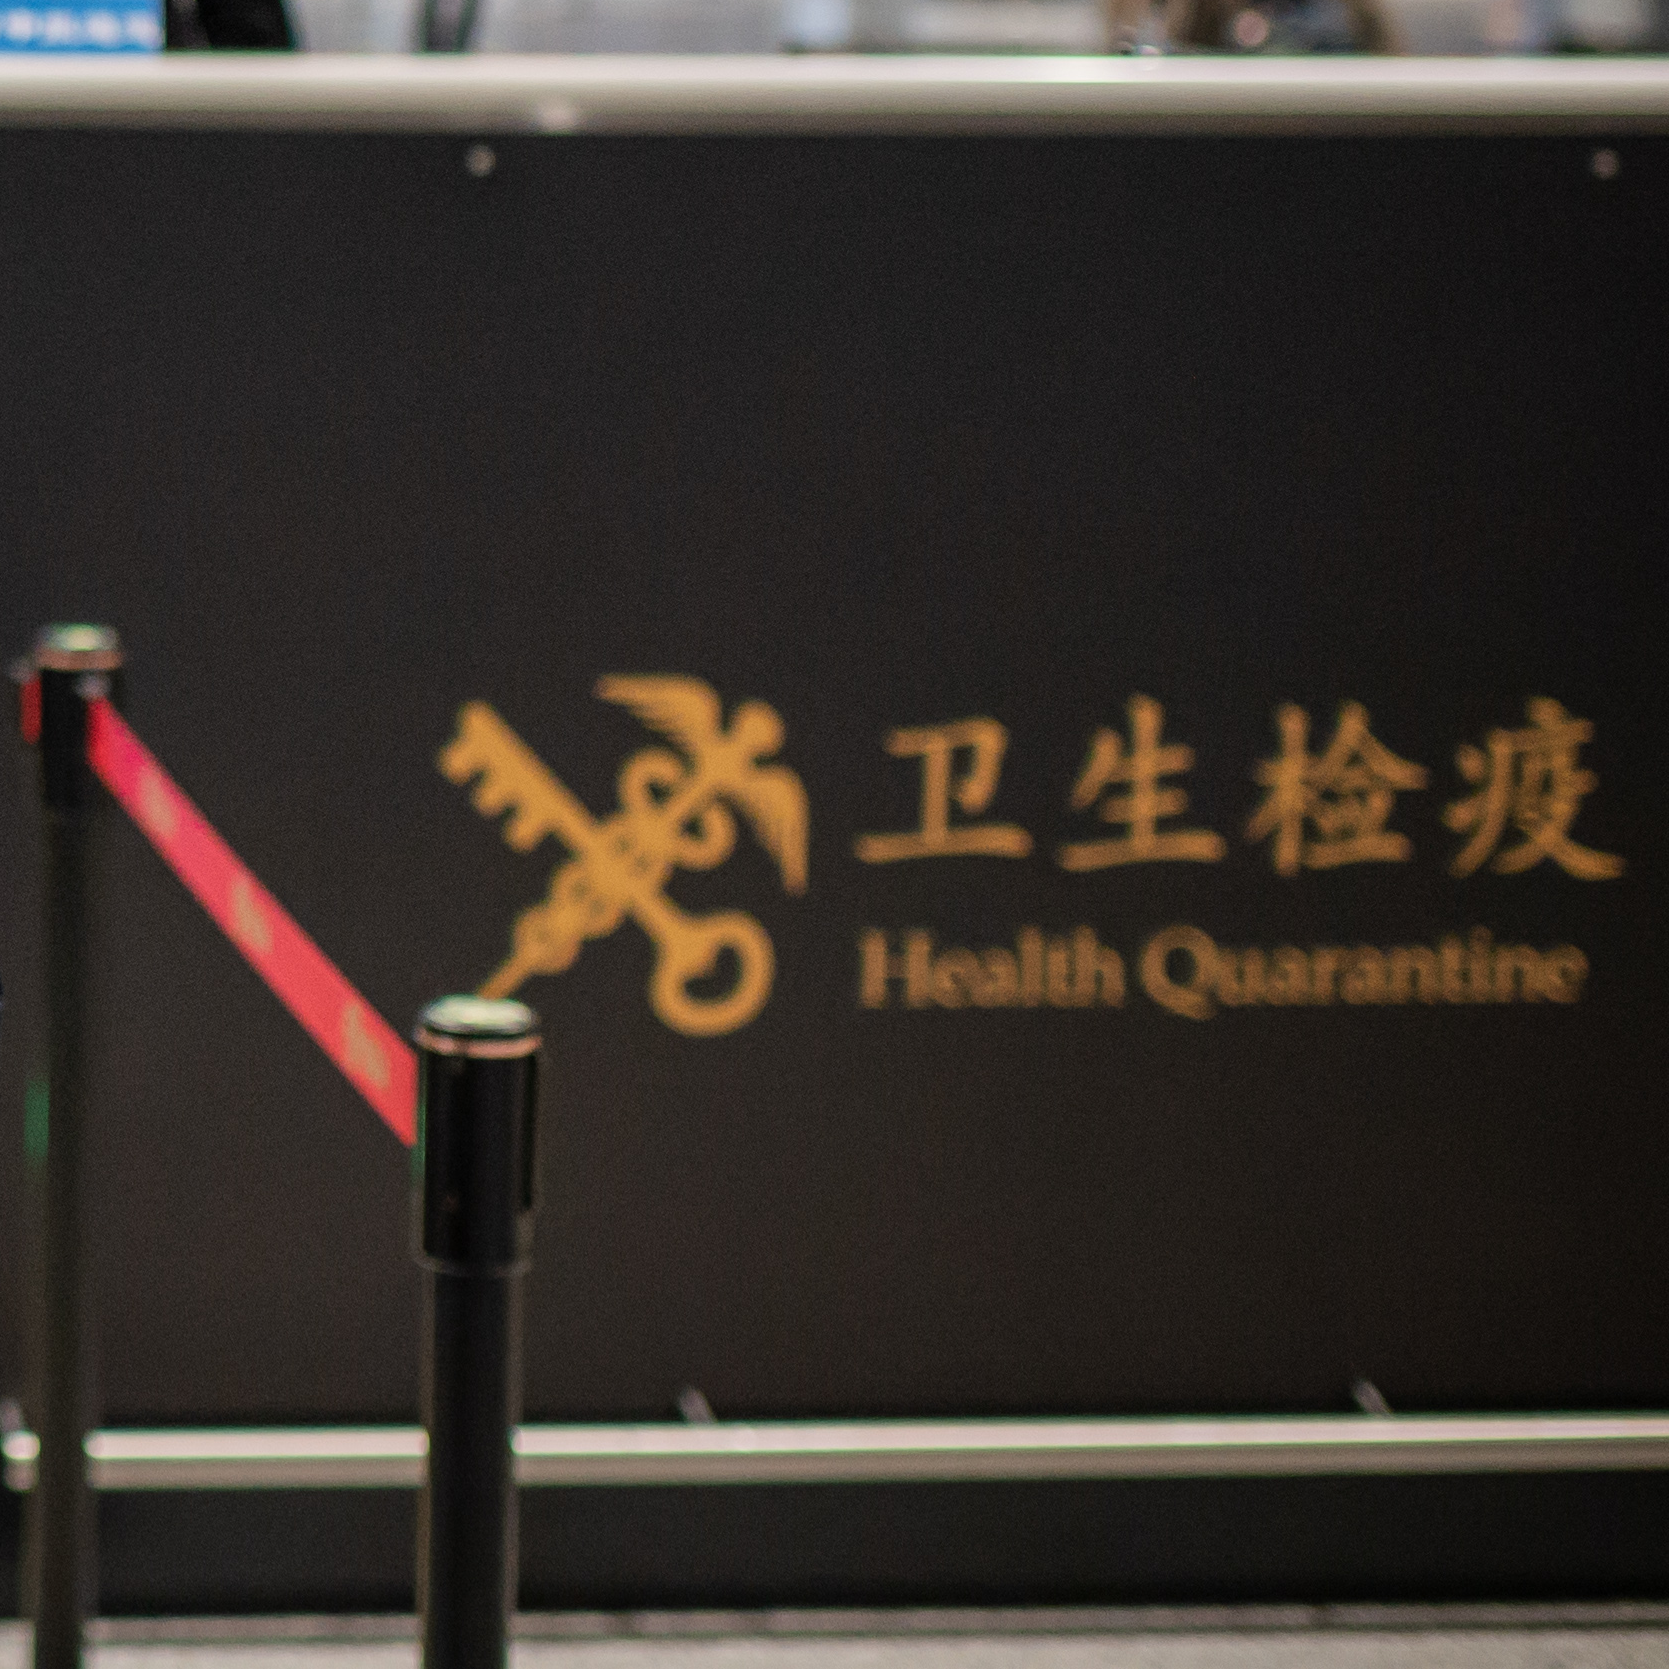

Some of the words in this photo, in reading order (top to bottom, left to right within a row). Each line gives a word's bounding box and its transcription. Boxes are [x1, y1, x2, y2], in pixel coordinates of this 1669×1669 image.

[854, 692, 1626, 881] 卫生检疫
[857, 923, 1127, 1010] Health
[1138, 923, 1590, 1021] Quarantine
